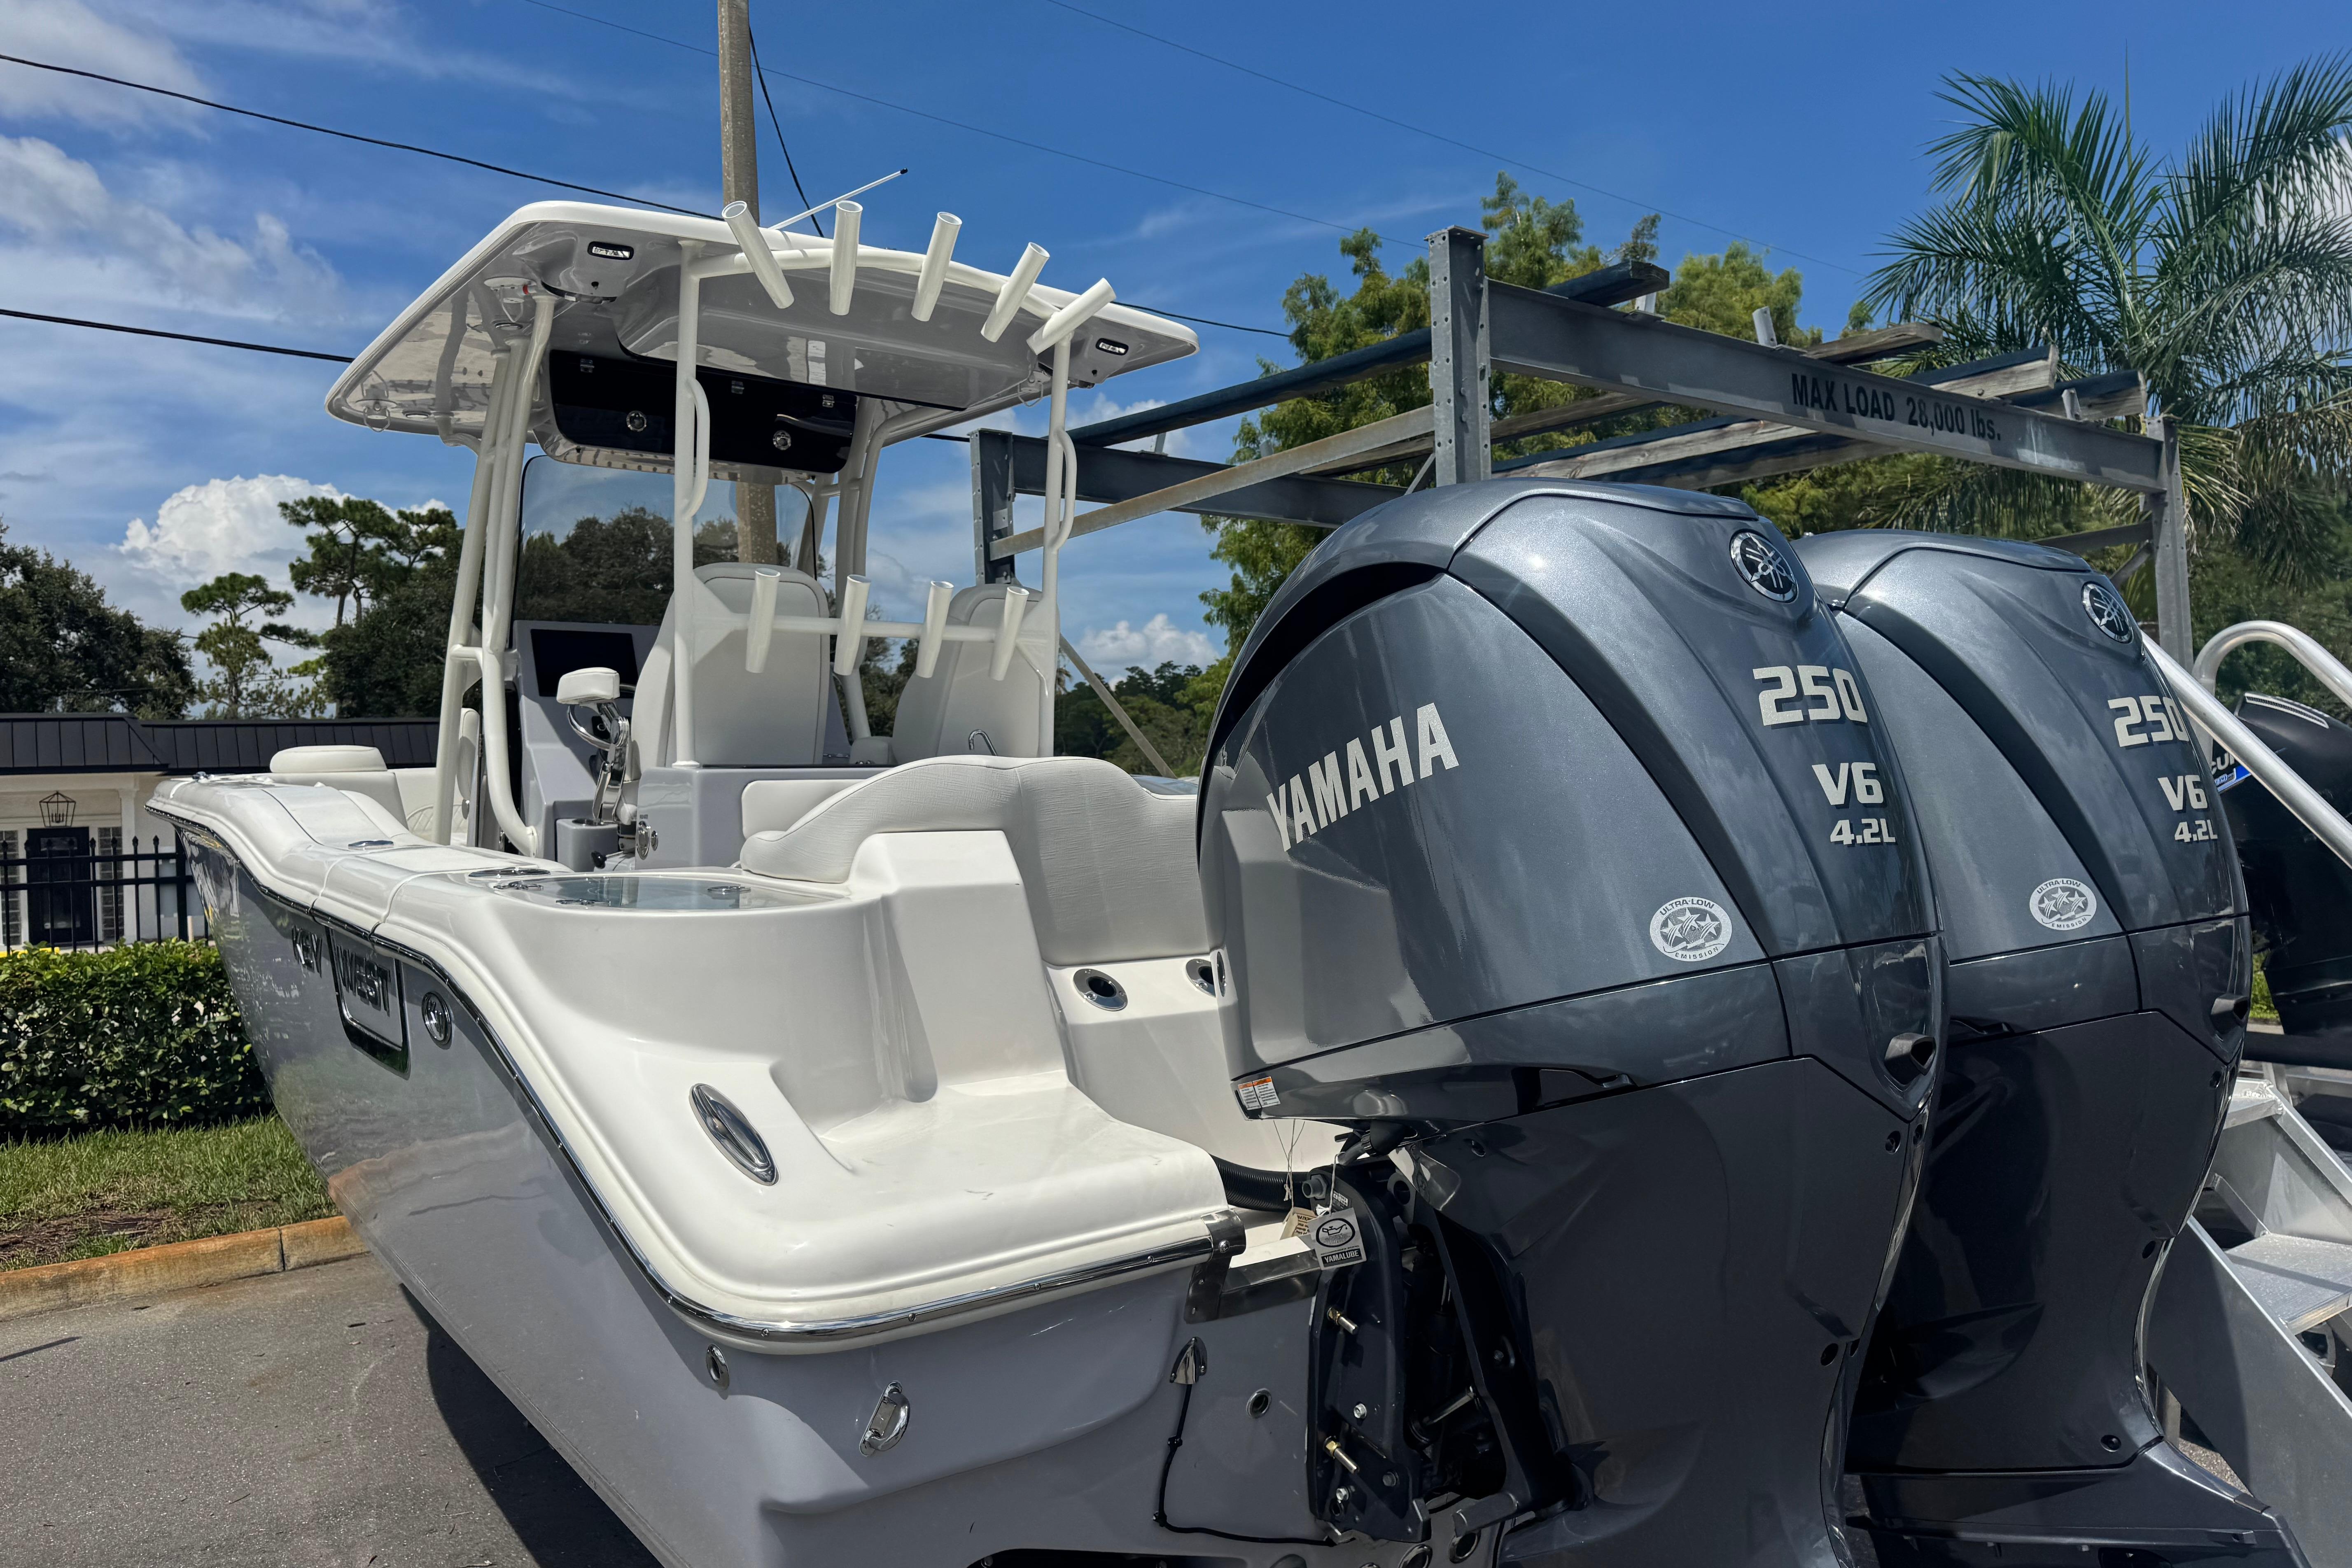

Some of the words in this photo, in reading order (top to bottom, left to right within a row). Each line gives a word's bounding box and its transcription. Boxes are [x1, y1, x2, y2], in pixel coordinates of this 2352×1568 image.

[1792, 373, 1837, 411] MAX
[1843, 383, 1895, 421] LOAD
[1906, 397, 1965, 436] 28,000
[1970, 408, 2001, 441] lbs.
[1752, 665, 1868, 726] 250
[2107, 696, 2190, 747] 250
[1266, 702, 1459, 852] YAMAHA
[1812, 762, 1884, 806] V6
[2158, 775, 2208, 811] V6
[1830, 818, 1896, 845] 4.2L
[2175, 819, 2218, 843] 4.2L
[292, 925, 322, 977] KEY
[336, 945, 391, 1016] WEST
[1675, 946, 1719, 959] EMISSION
